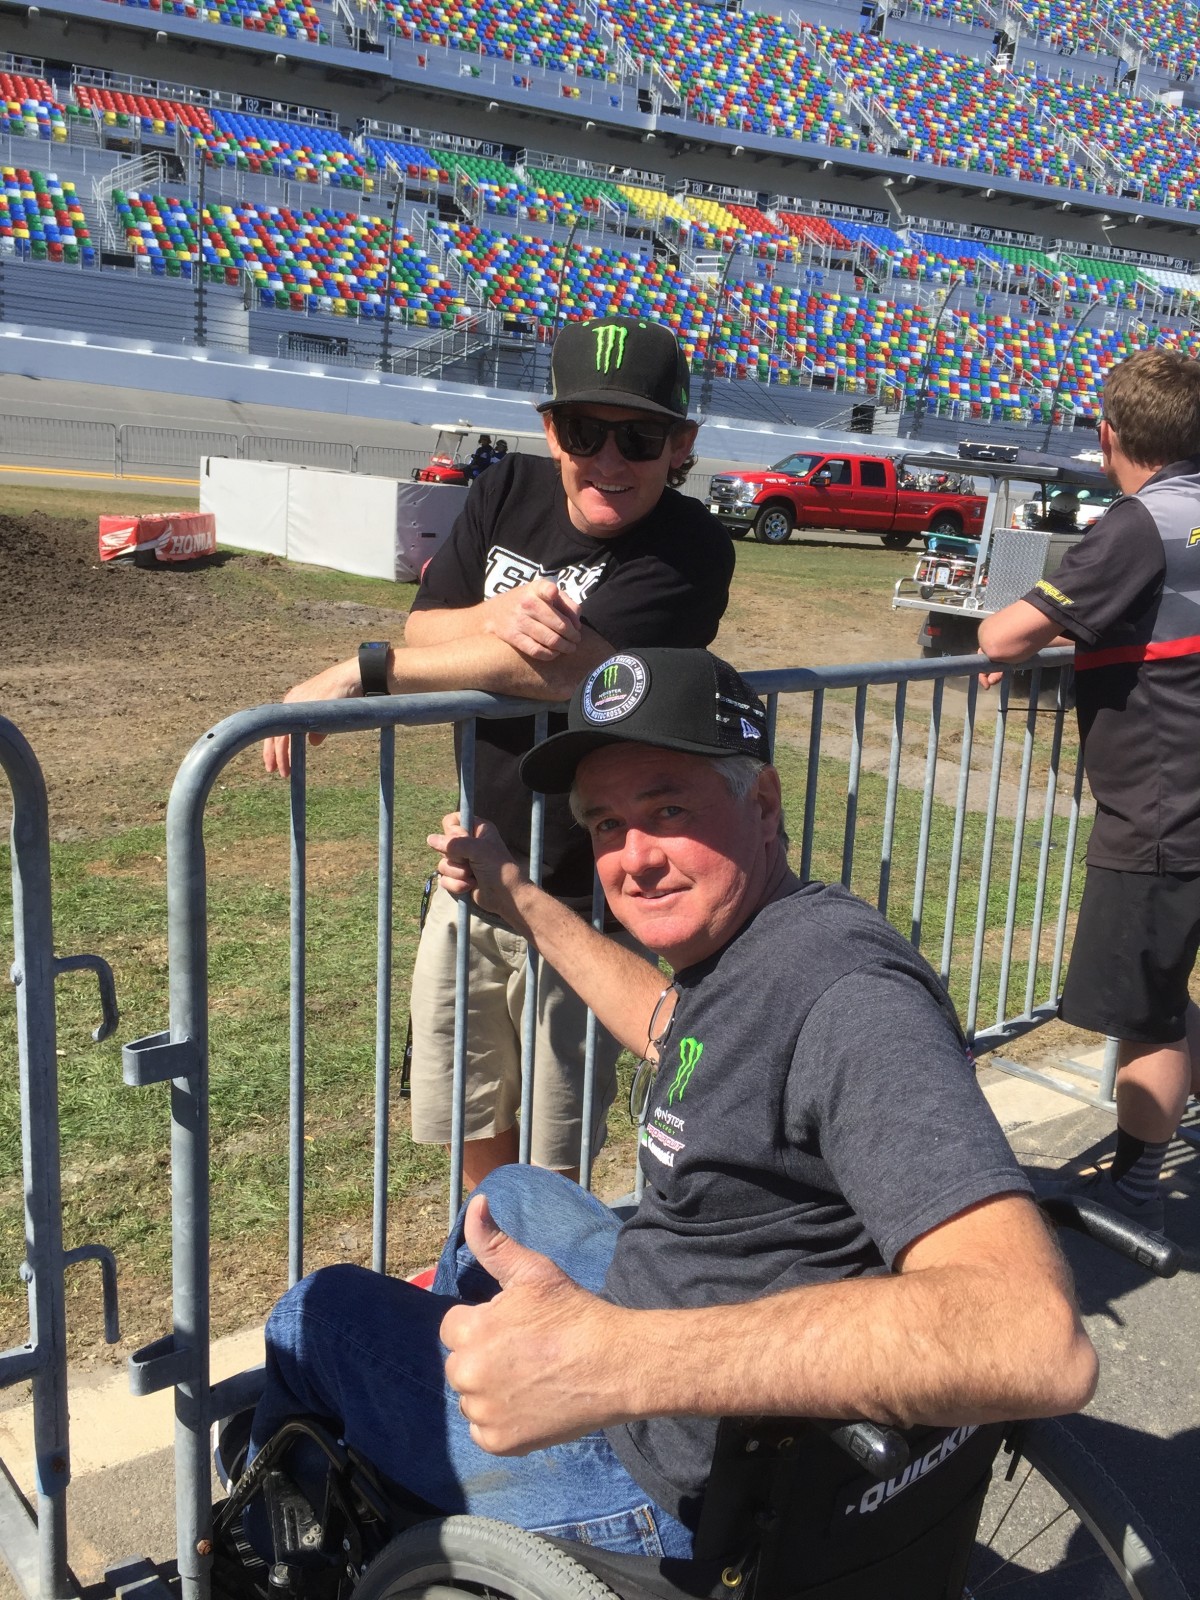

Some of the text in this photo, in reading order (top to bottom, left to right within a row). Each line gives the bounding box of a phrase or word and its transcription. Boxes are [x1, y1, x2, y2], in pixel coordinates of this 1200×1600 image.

[245, 98, 259, 112] 132
[482, 142, 493, 156] 131
[692, 182, 703, 195] 130
[873, 211, 884, 224] 129
[590, 707, 623, 720] MOTOCROSS
[622, 695, 637, 711] TEAM
[654, 1106, 685, 1132] MONSTER
[654, 1119, 676, 1136] ENERGY
